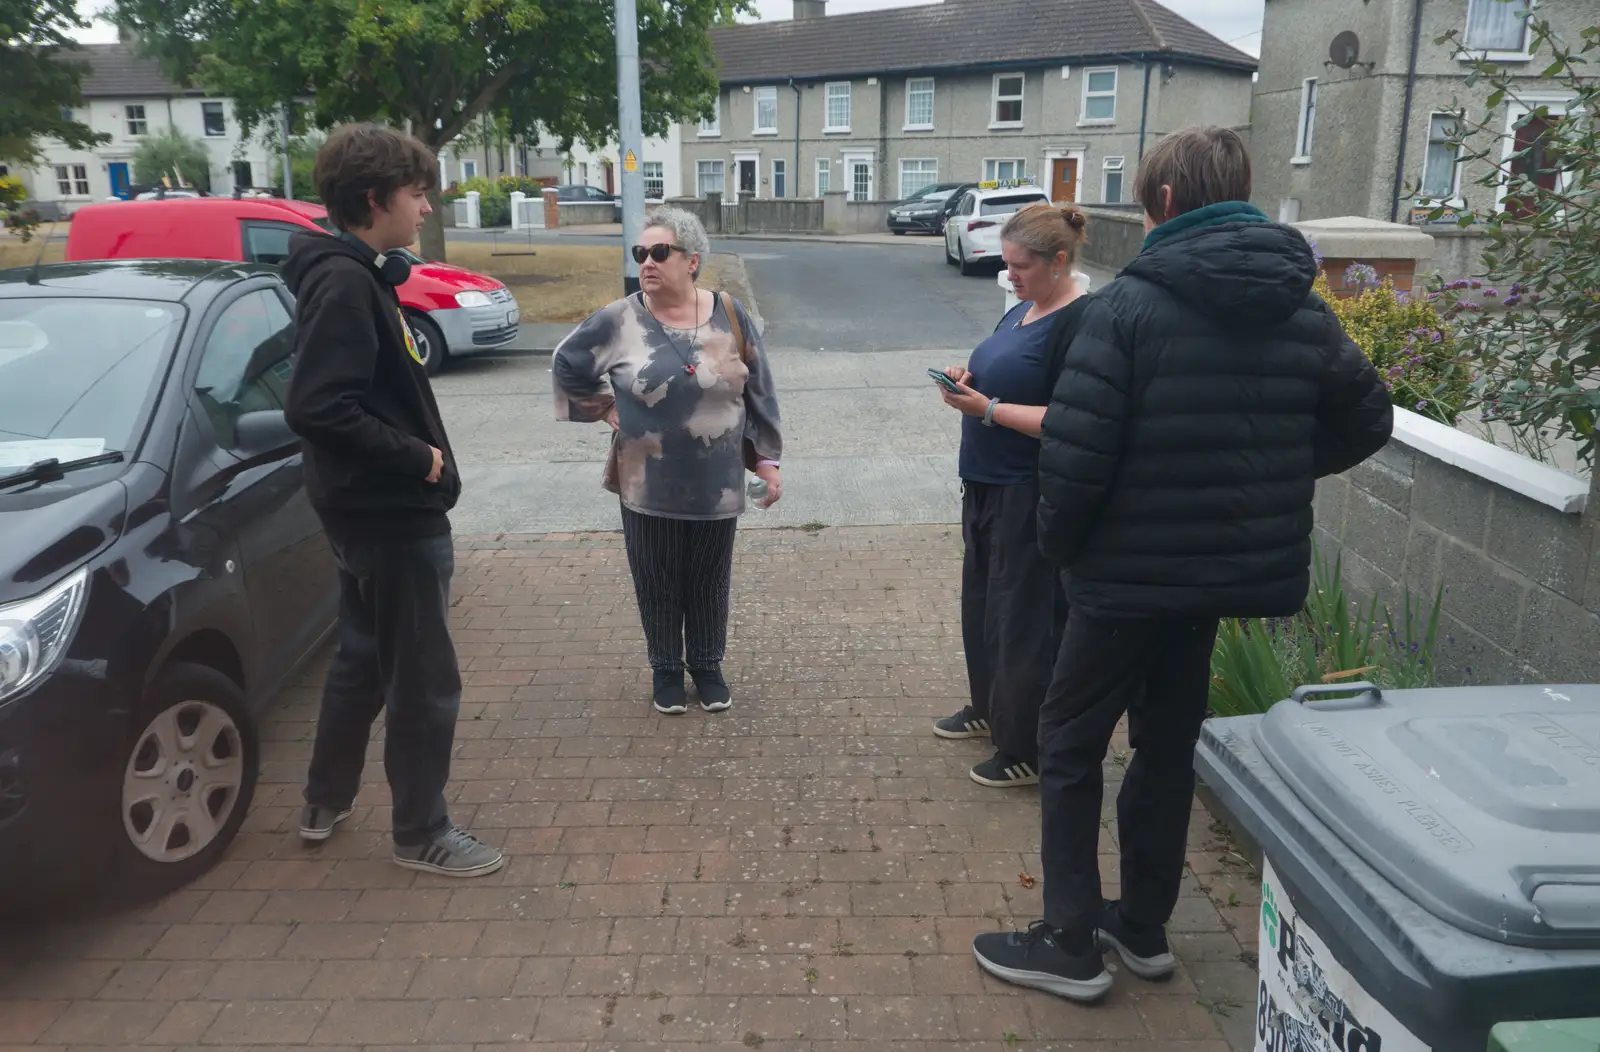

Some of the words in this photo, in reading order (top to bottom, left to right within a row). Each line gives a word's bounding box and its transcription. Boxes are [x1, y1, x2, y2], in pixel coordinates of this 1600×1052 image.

[1328, 739, 1360, 757] HOT
[1354, 762, 1401, 794] ASHES
[1397, 800, 1462, 849] PLEASE
